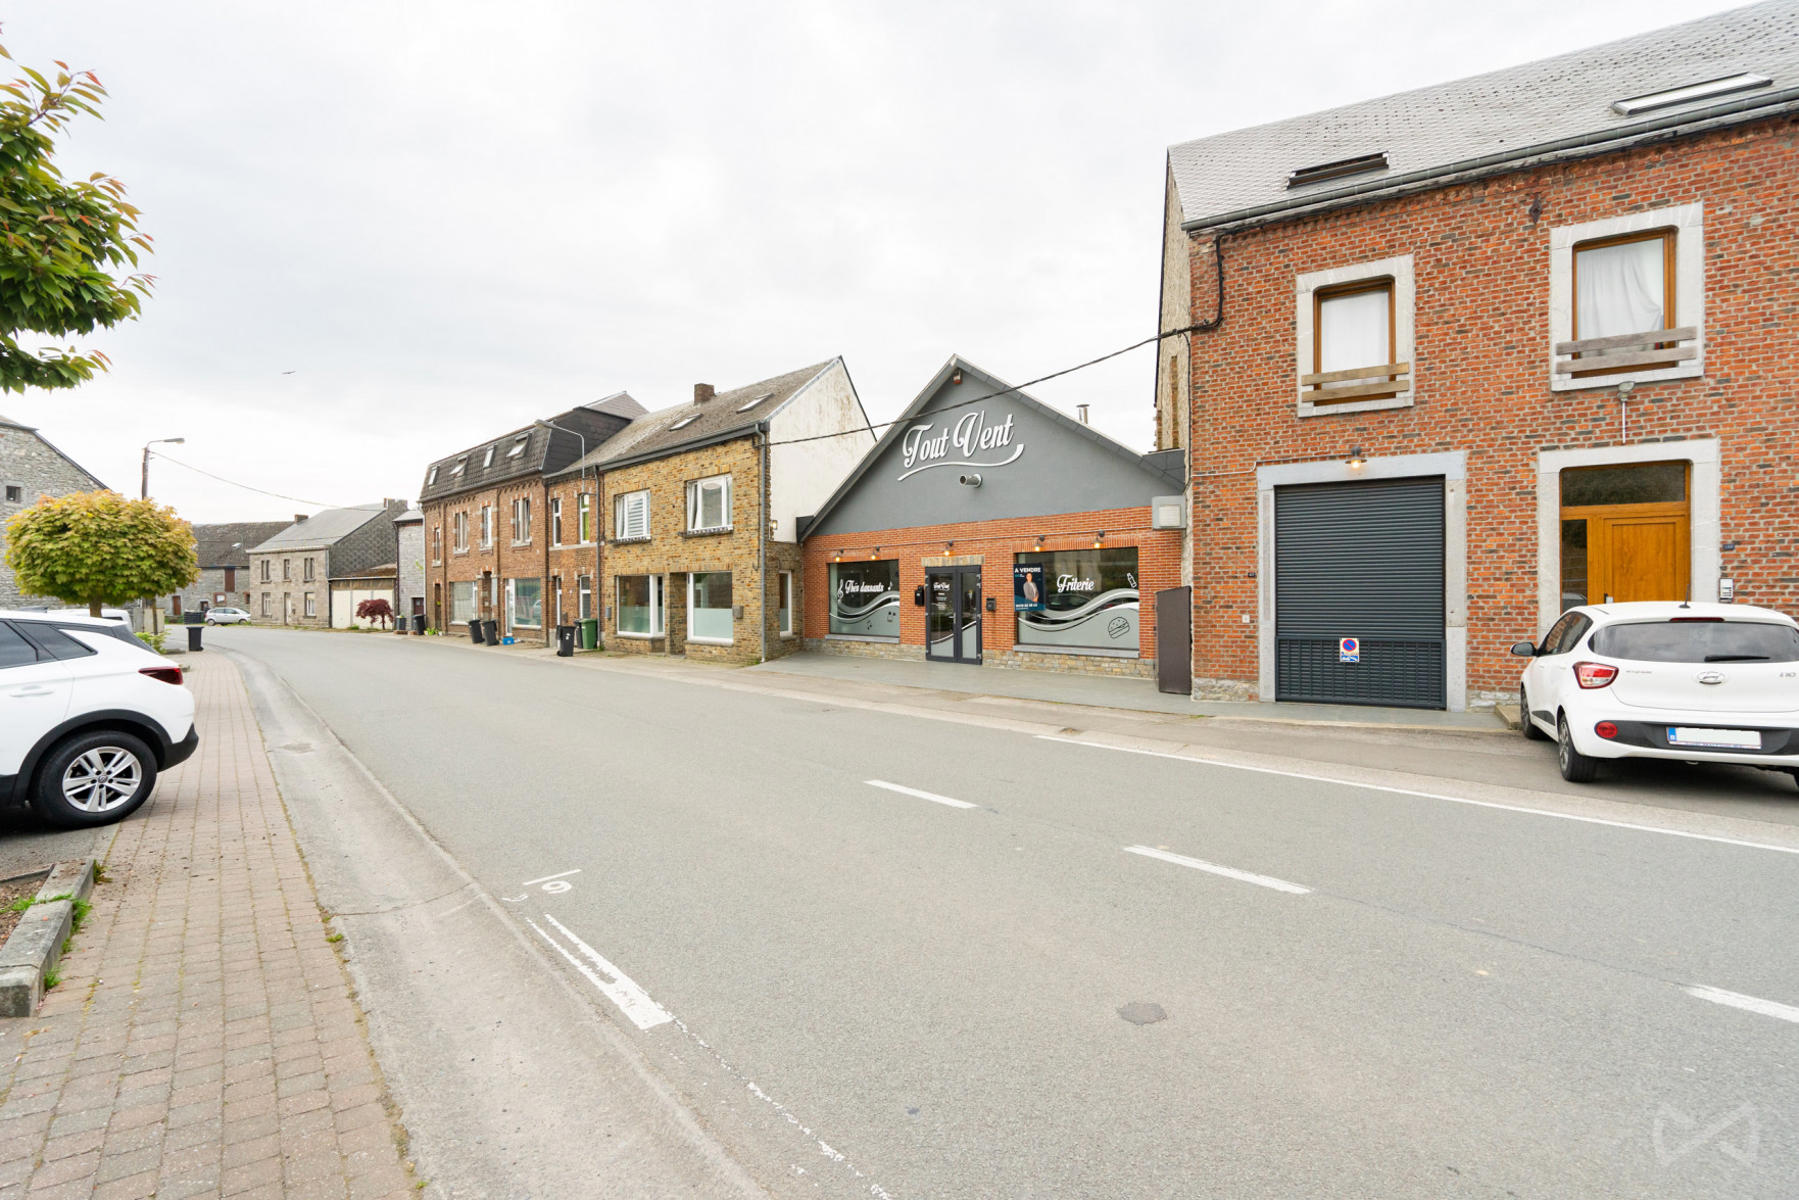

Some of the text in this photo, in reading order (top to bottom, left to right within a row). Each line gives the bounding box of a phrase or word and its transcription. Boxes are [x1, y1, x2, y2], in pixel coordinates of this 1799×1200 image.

[902, 410, 1013, 468] Tout Vent
[1056, 574, 1095, 593] Friterie
